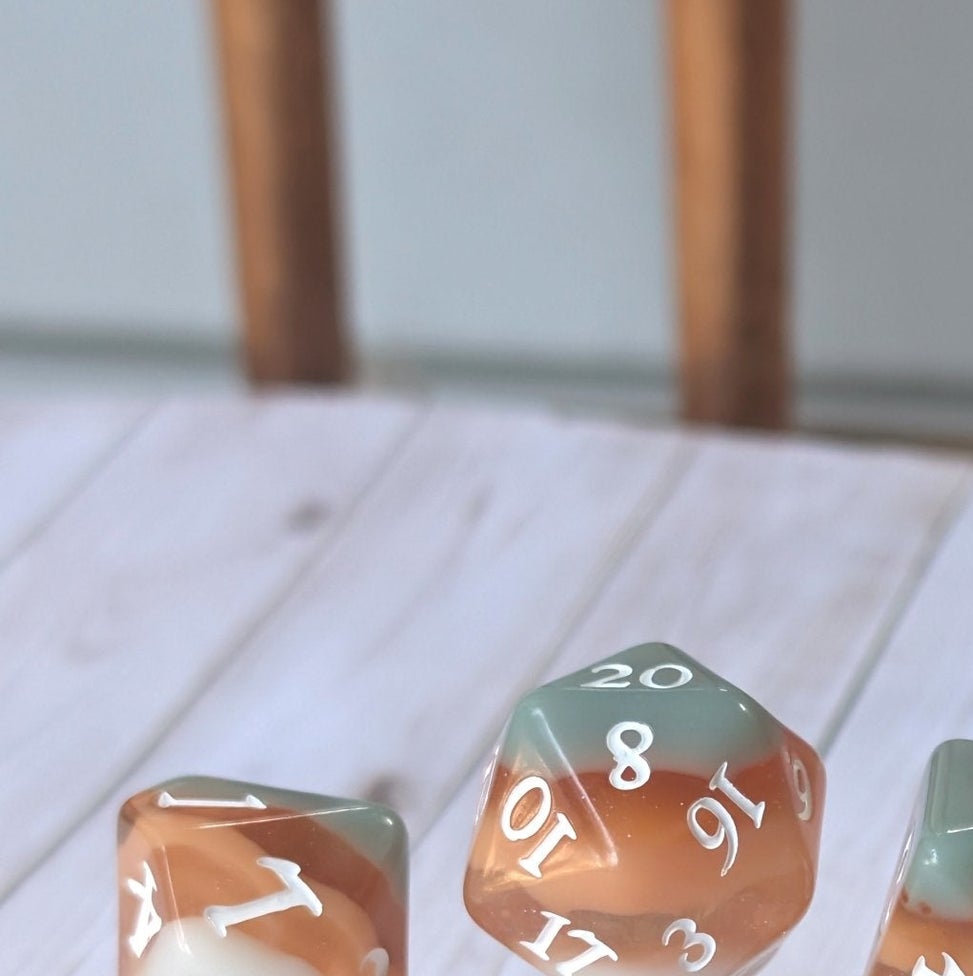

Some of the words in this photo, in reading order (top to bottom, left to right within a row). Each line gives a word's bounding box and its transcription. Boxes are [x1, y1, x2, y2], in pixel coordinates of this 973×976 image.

[580, 663, 693, 689] 20
[606, 721, 654, 790] 8
[501, 775, 576, 878] 10
[662, 918, 716, 972] 3
